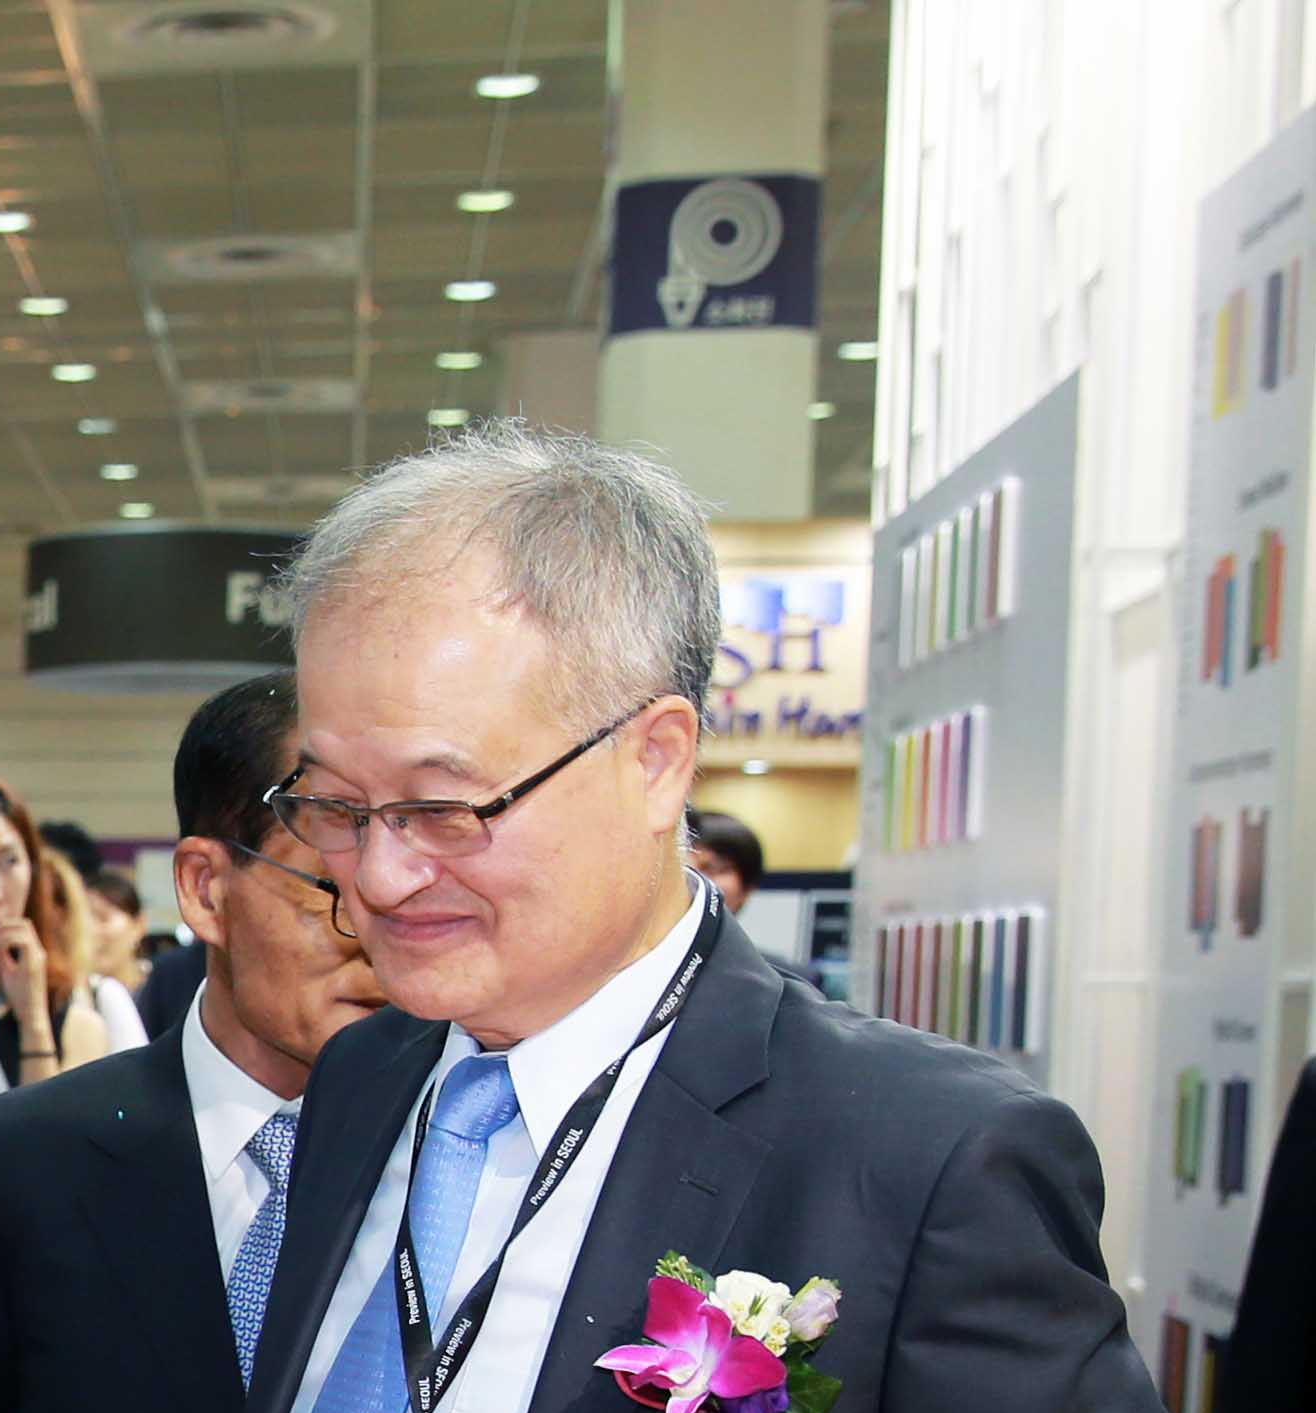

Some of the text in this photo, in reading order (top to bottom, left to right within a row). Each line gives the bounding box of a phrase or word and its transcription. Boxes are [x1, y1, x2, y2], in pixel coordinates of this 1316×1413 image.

[530, 1171, 558, 1206] Preview
[555, 1127, 584, 1160] SEOUL
[398, 1248, 414, 1279] SEOUL
[404, 1290, 420, 1325] Preview
